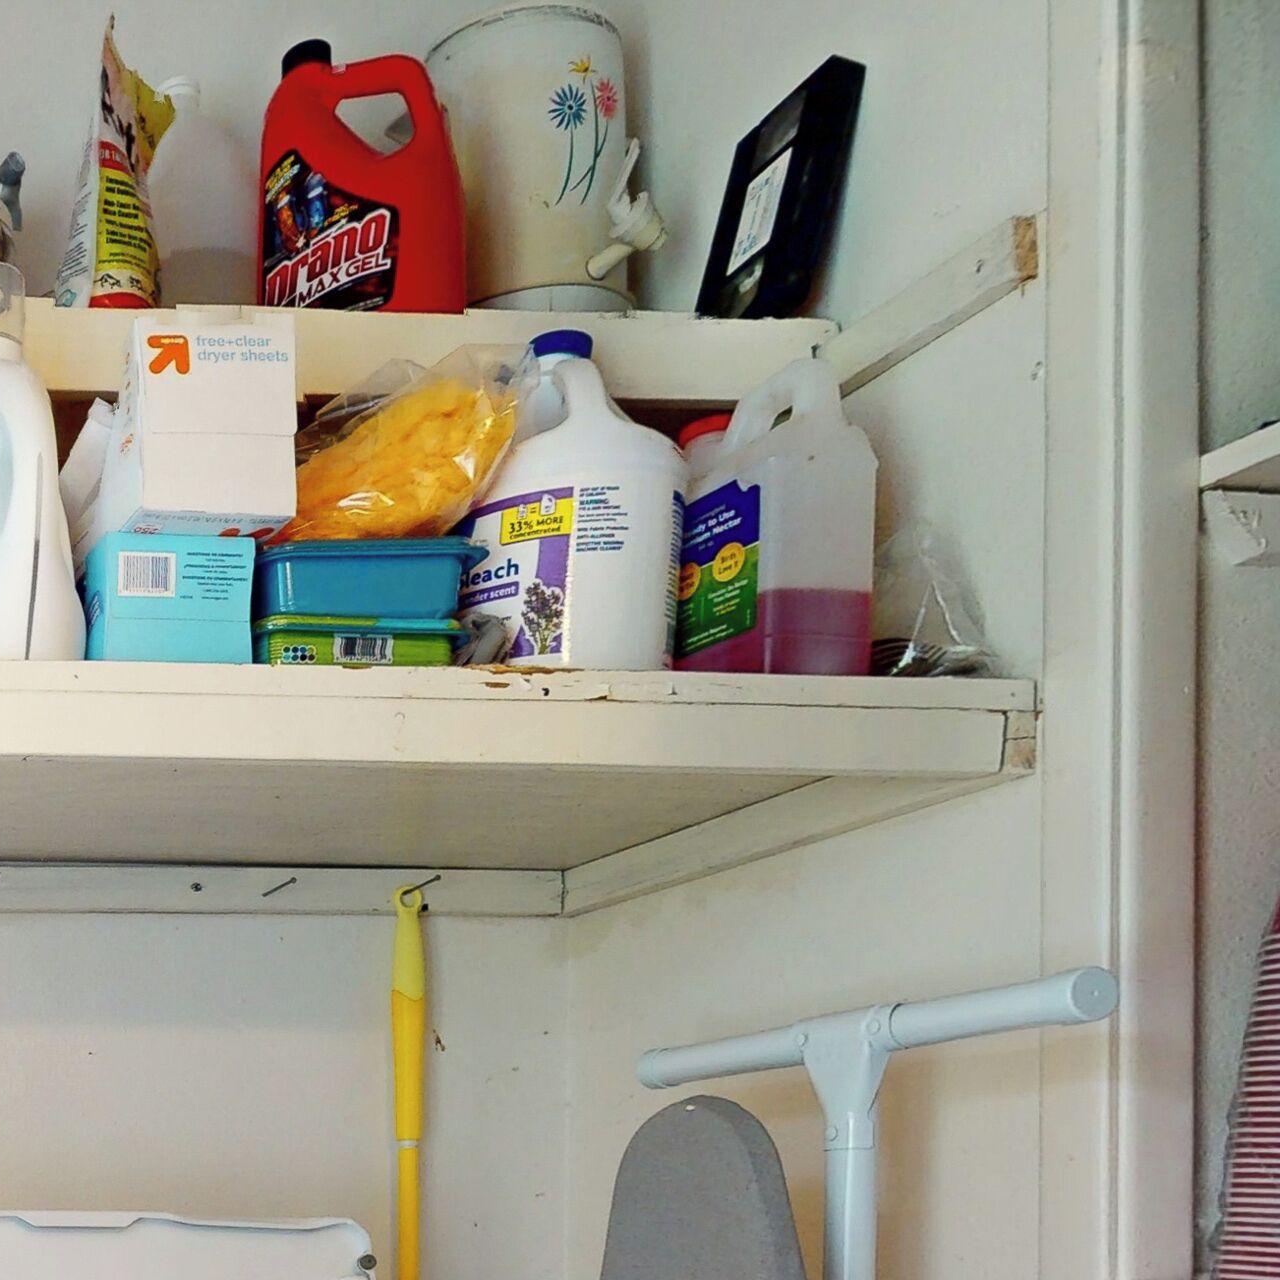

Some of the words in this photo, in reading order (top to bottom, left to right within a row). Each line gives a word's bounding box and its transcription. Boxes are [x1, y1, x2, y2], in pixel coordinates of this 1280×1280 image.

[298, 266, 342, 306] MAX
[345, 251, 388, 278] GEL
[196, 335, 272, 347] free+clear
[197, 349, 236, 363] dryer
[240, 349, 289, 362] sheets
[509, 521, 533, 534] 33%
[536, 515, 564, 526] MORE
[708, 518, 717, 527] to
[718, 510, 736, 522] Use
[712, 516, 742, 536] Nectar
[509, 526, 561, 540] concentrated
[489, 585, 517, 599] scent
